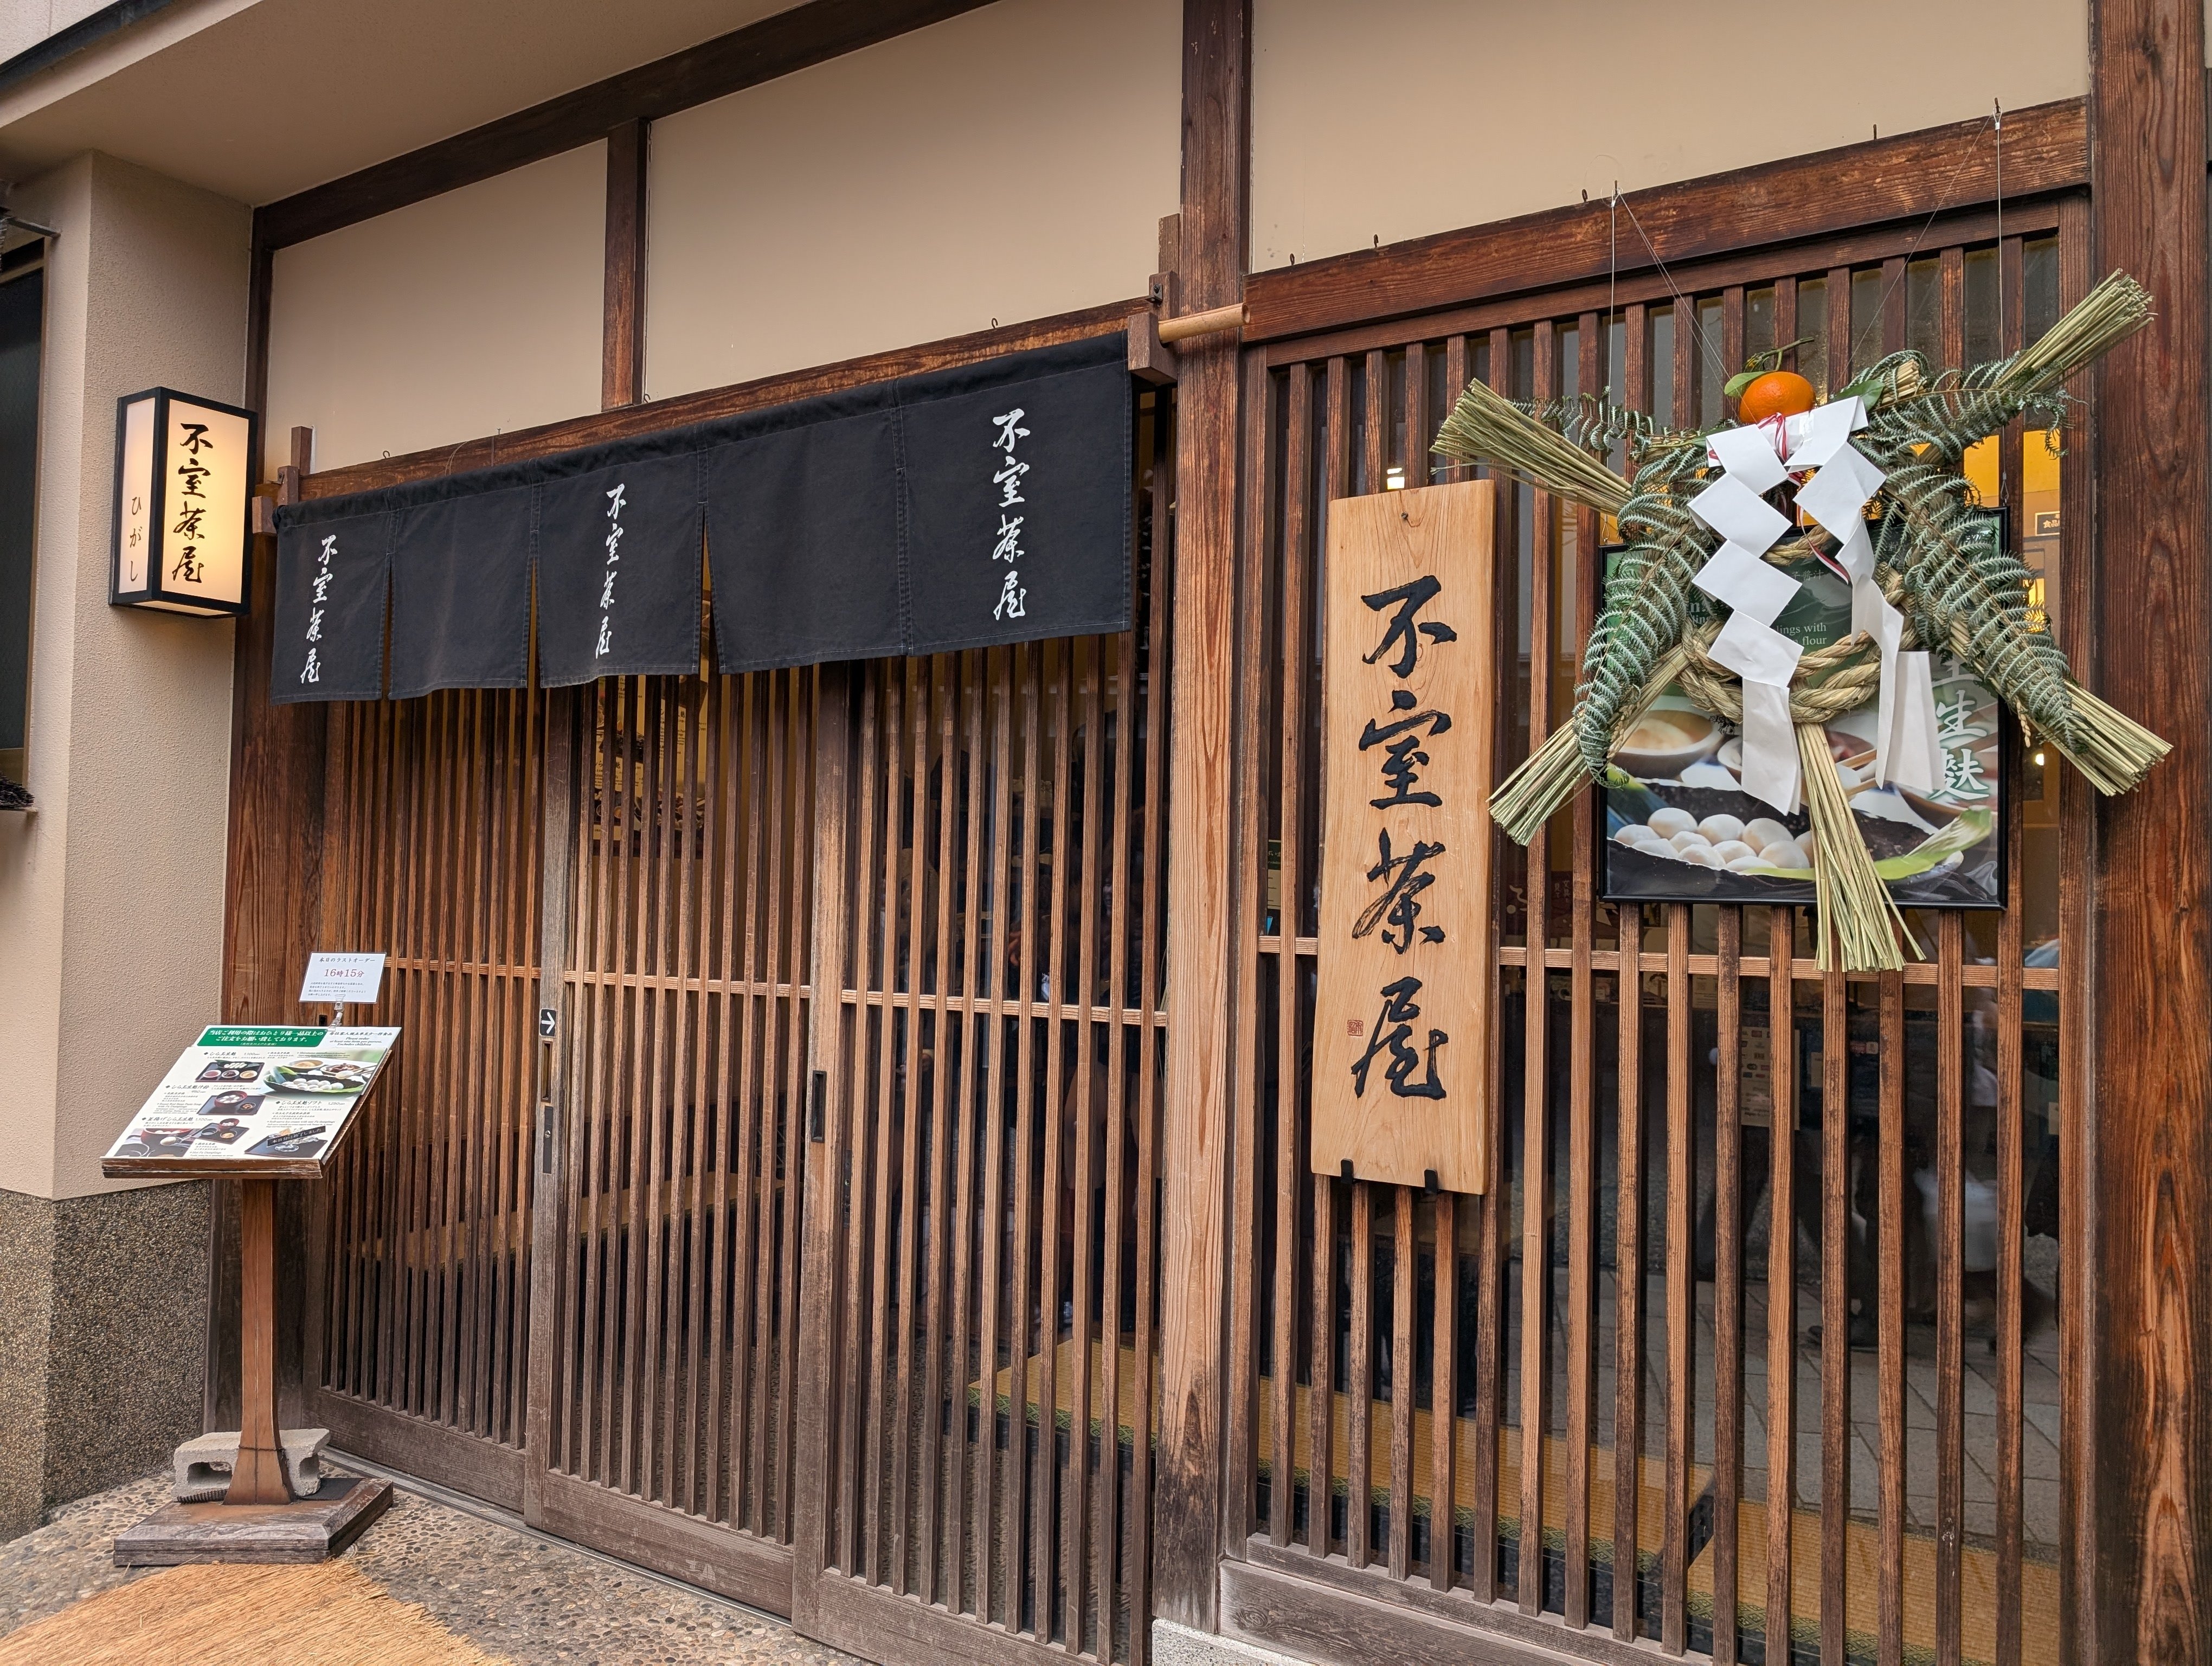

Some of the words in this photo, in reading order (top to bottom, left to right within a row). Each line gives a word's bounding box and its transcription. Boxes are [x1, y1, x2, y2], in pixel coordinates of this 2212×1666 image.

[130, 496, 143, 582] ひがし
[171, 422, 214, 584] 不室茶屋
[992, 408, 1031, 621] 不室茶屋
[2043, 520, 2060, 529] 食品
[300, 534, 338, 684] 不室茶屋
[595, 483, 627, 659] 不室茶屋
[1804, 622, 1827, 632] with
[1802, 636, 1827, 645] flour
[1351, 575, 1458, 1101] 不室茶屋
[324, 969, 364, 977] 16時15分
